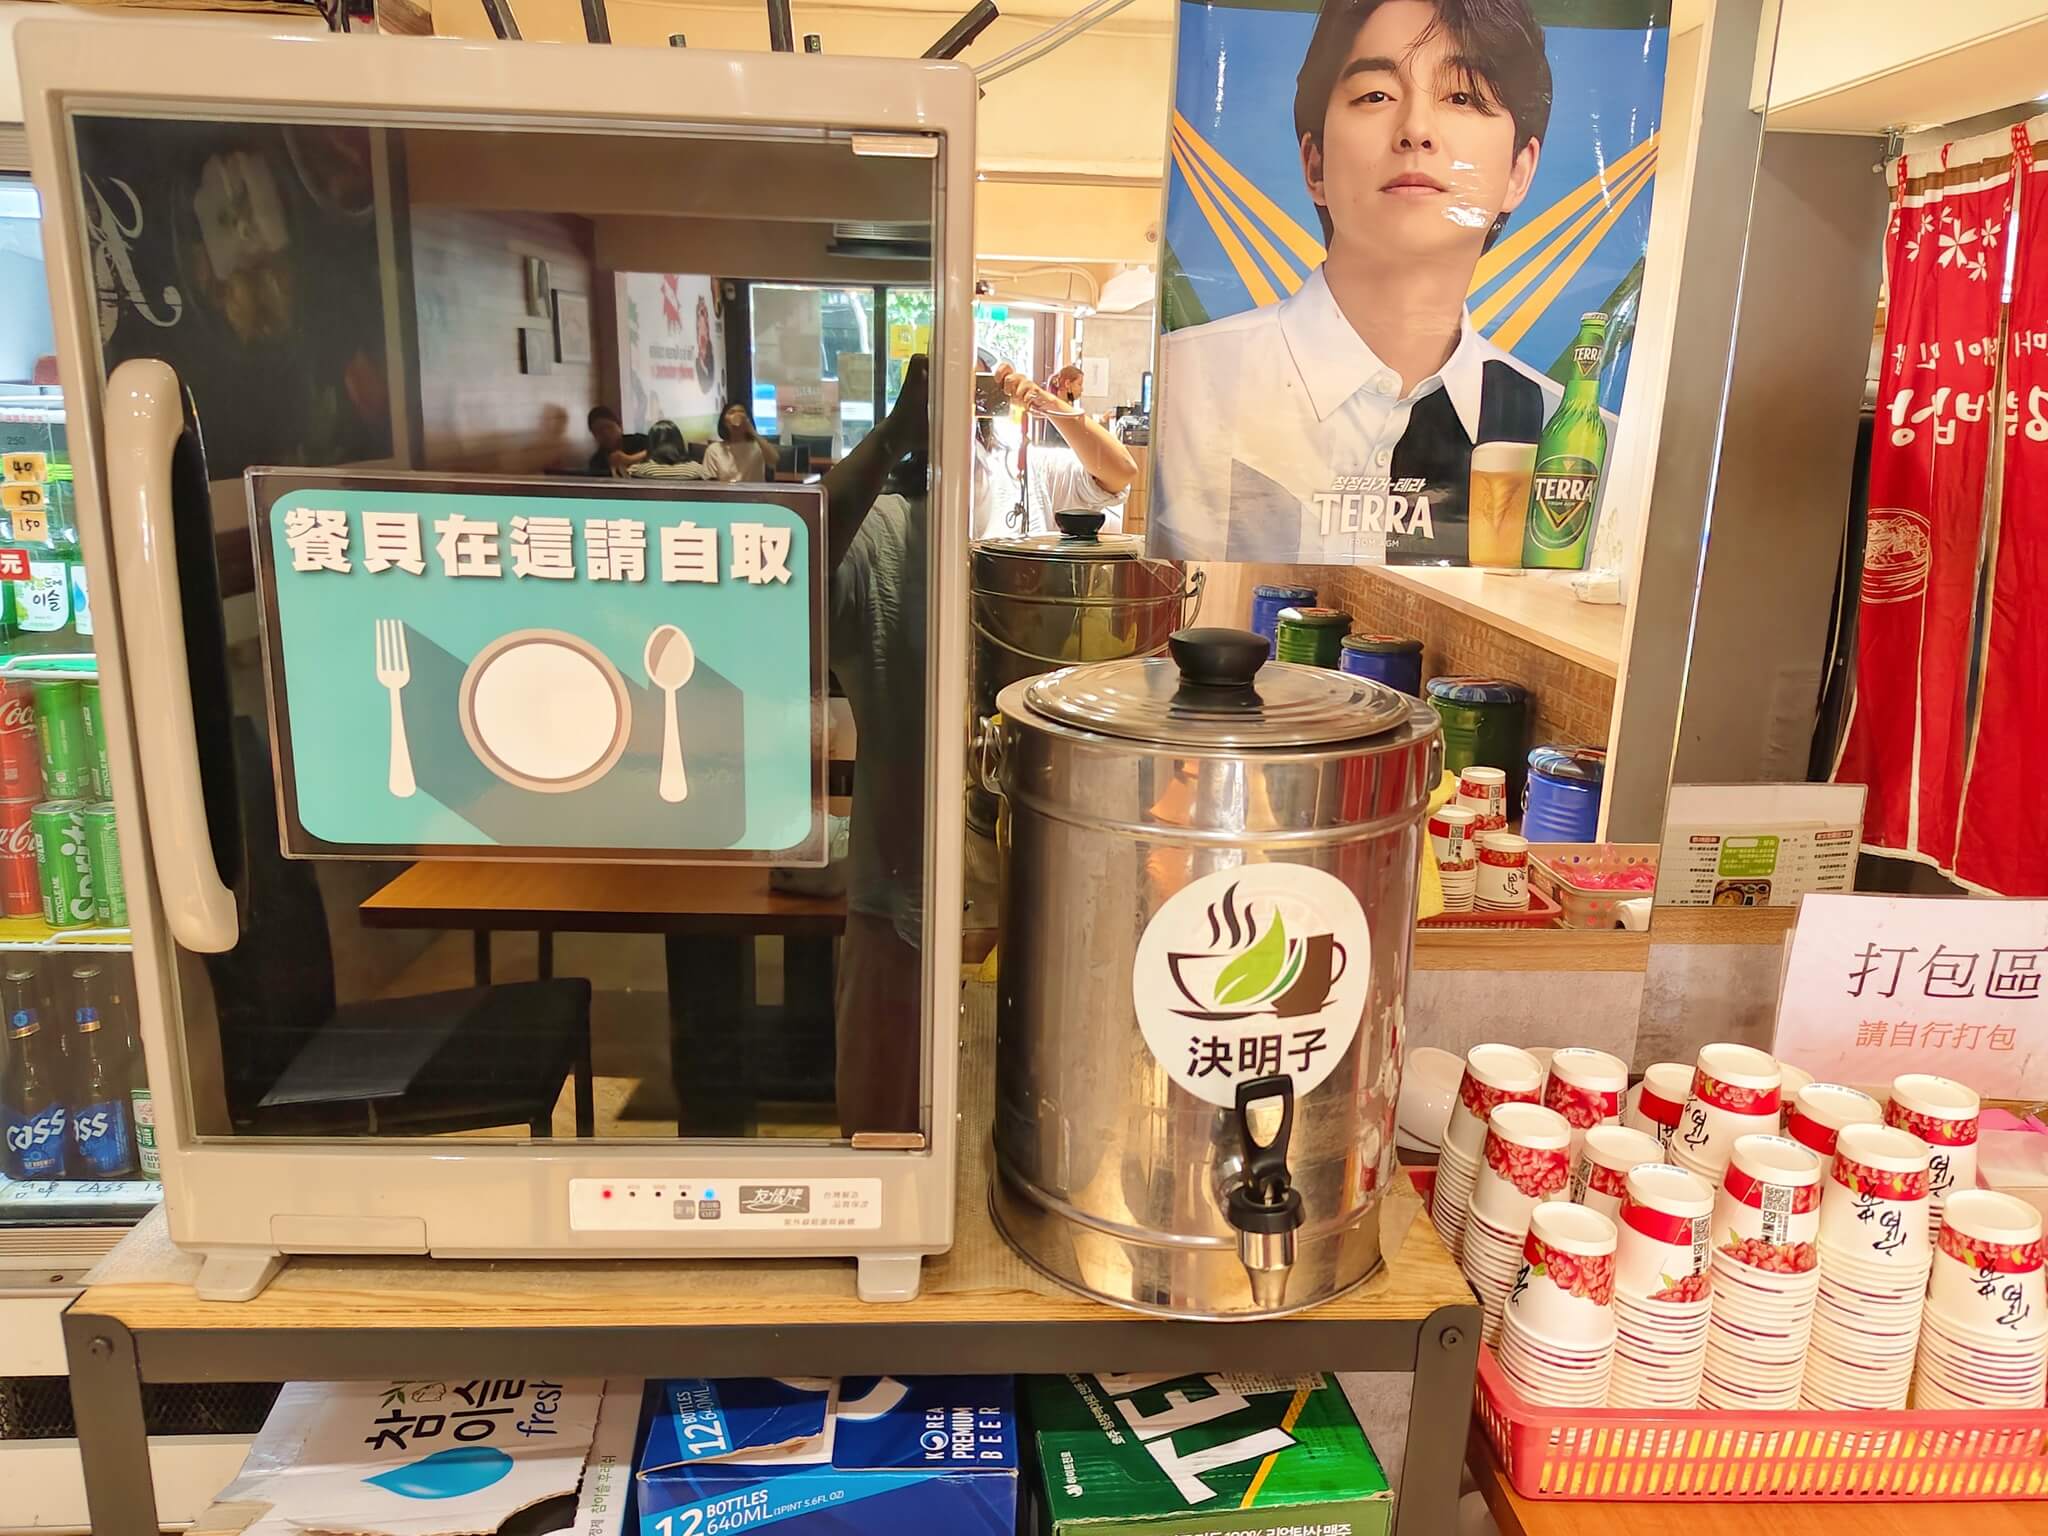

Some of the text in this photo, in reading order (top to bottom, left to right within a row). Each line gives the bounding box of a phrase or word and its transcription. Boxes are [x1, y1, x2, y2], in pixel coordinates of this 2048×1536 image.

[13, 461, 32, 473] 40
[1535, 478, 1595, 502] TERRA
[1312, 493, 1434, 539] TERRA
[0, 553, 24, 575] 元
[32, 589, 61, 612] 이슬
[1847, 942, 2048, 1000] 打包區
[1855, 1019, 2017, 1051] 請自行打包
[1186, 1027, 1328, 1078] 決明子
[675, 1390, 699, 1426] BOTTLES
[683, 1420, 728, 1456] 12
[920, 1407, 949, 1460] KOREA
[951, 1407, 976, 1460] PREMIUM
[979, 1407, 1004, 1460] BEER
[706, 1489, 769, 1519] BOTTLES
[706, 1503, 774, 1536] 640ML
[655, 1508, 705, 1536] 12
